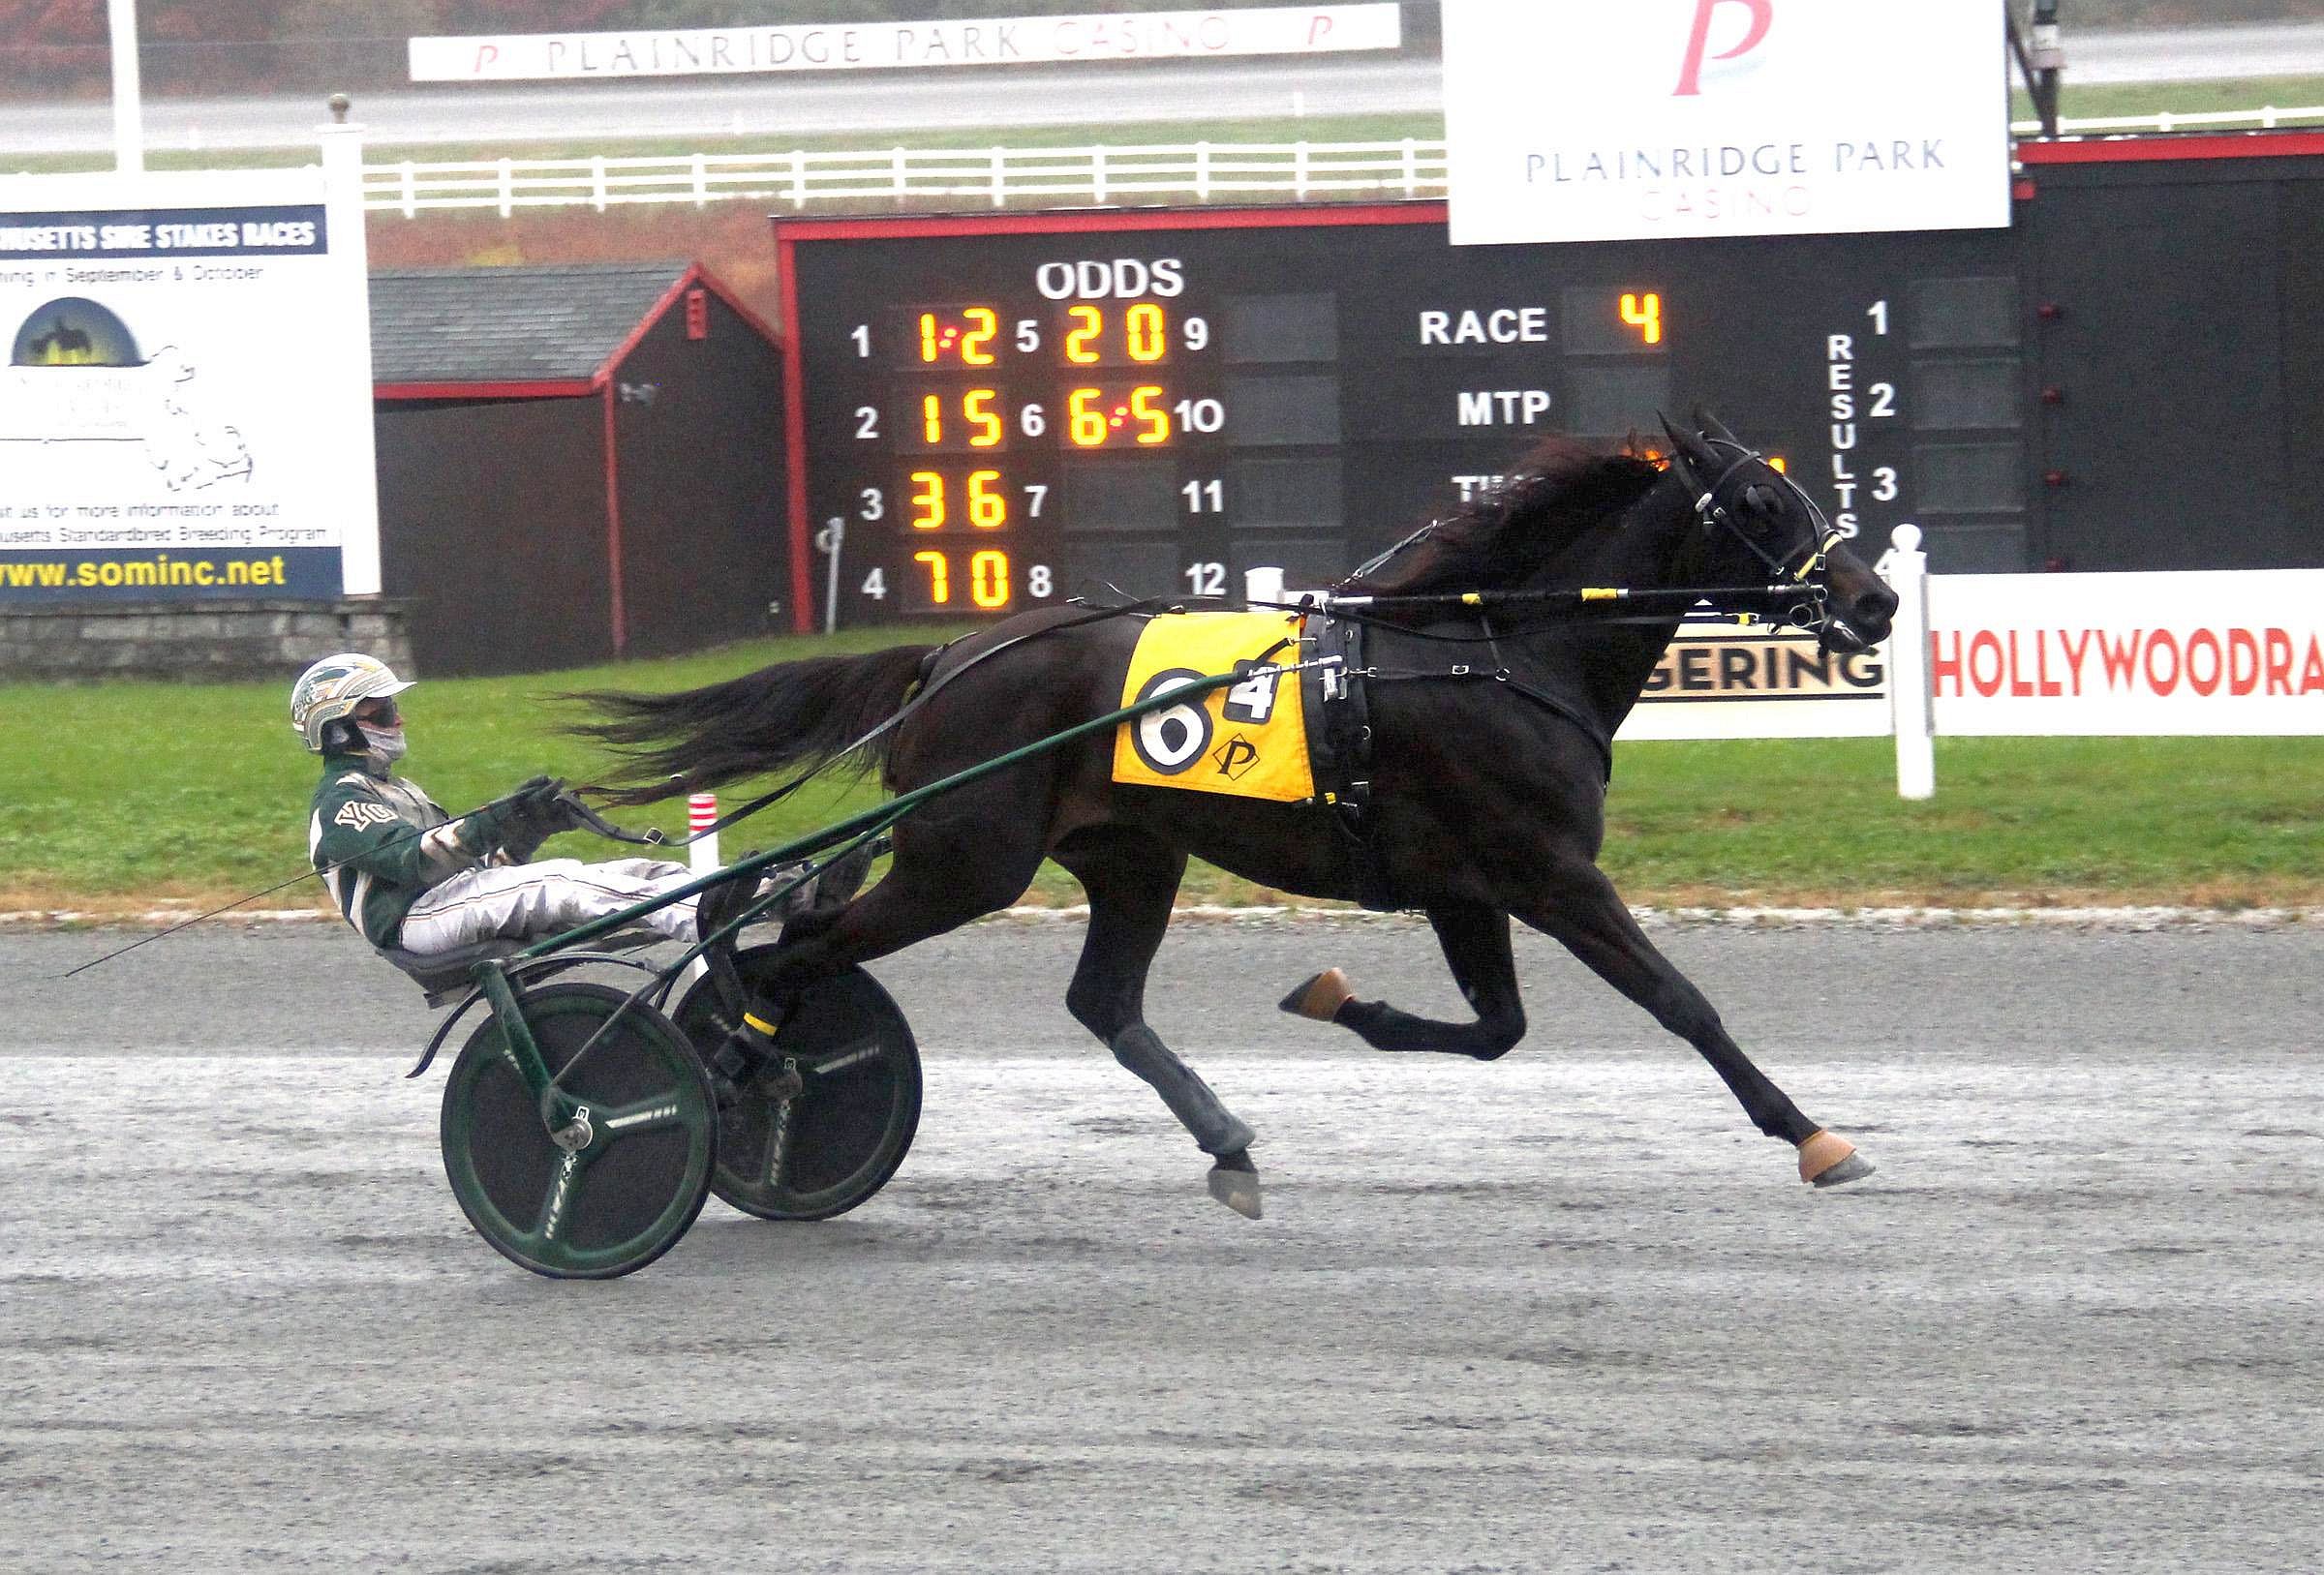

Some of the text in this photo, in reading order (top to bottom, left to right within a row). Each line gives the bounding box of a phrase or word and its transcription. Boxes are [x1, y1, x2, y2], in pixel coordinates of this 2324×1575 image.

[547, 31, 861, 73] PLAINRIDGE
[896, 24, 1020, 60] PARK
[1054, 16, 1231, 54] CASINO
[1526, 138, 1945, 183] PLAINRIDGE PARK
[1640, 186, 1813, 221] CASINO
[155, 223, 239, 248] STAKES
[242, 222, 316, 246] RACES
[65, 266, 164, 286] September
[173, 266, 183, 281] &
[193, 265, 264, 281] October
[1036, 258, 1184, 300] ODDS
[1420, 292, 1662, 346] RACE 4
[1867, 300, 1887, 336] 1
[851, 325, 870, 357] 1
[1017, 320, 1040, 352] 5
[1183, 318, 1209, 350] 9
[854, 407, 879, 439] 2
[1021, 404, 1045, 438] 6
[1174, 399, 1226, 433] 10
[1458, 389, 1550, 427] MTP
[1869, 382, 1895, 418] 2
[1827, 334, 1857, 540] RESULTS
[861, 488, 883, 522] 3
[1024, 485, 1048, 518] 7
[1181, 480, 1224, 513] 11
[1872, 466, 1898, 501] 3
[20, 506, 40, 519] us
[46, 504, 69, 518] for
[77, 506, 120, 518] more
[127, 503, 223, 517] information
[231, 503, 280, 517] about
[0, 526, 326, 545] usetts Standardbred Breeding Program
[0, 554, 286, 588] ww.sominc.net
[861, 568, 884, 600] 4
[1028, 565, 1053, 598] 8
[1184, 562, 1227, 596] 12
[1929, 627, 2324, 697] HOLLYWOODRA
[1229, 667, 1279, 719] 4
[1140, 678, 1204, 766] 6
[1217, 742, 1257, 774] P
